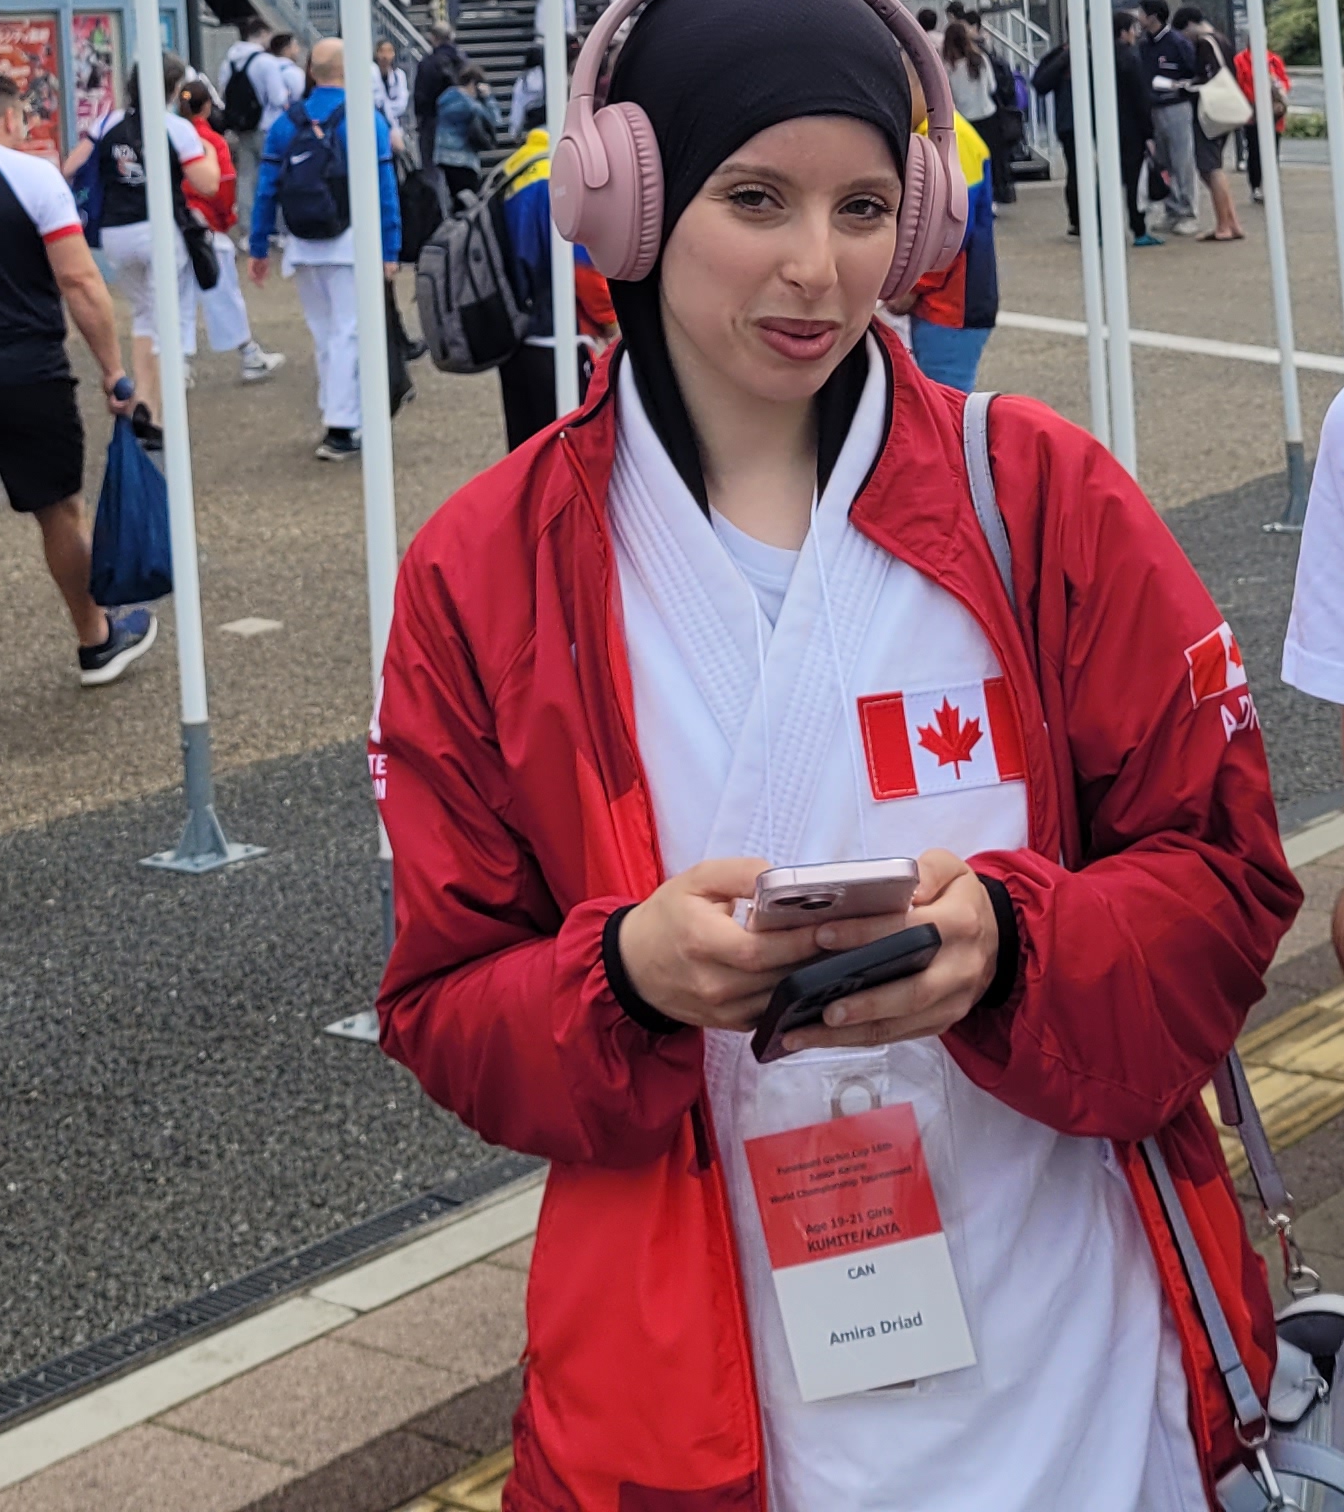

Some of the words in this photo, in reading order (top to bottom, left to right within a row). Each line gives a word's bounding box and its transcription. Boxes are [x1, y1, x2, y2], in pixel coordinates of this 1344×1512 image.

[861, 1165, 913, 1184] Tournament
[806, 1221, 828, 1235] Age
[831, 1213, 864, 1229] 19-21
[867, 1206, 894, 1220] Girls
[807, 1221, 901, 1254] KUMITE/KATA
[847, 1263, 876, 1279] CAN
[830, 1325, 876, 1345] Amira
[880, 1311, 923, 1334] Driad
